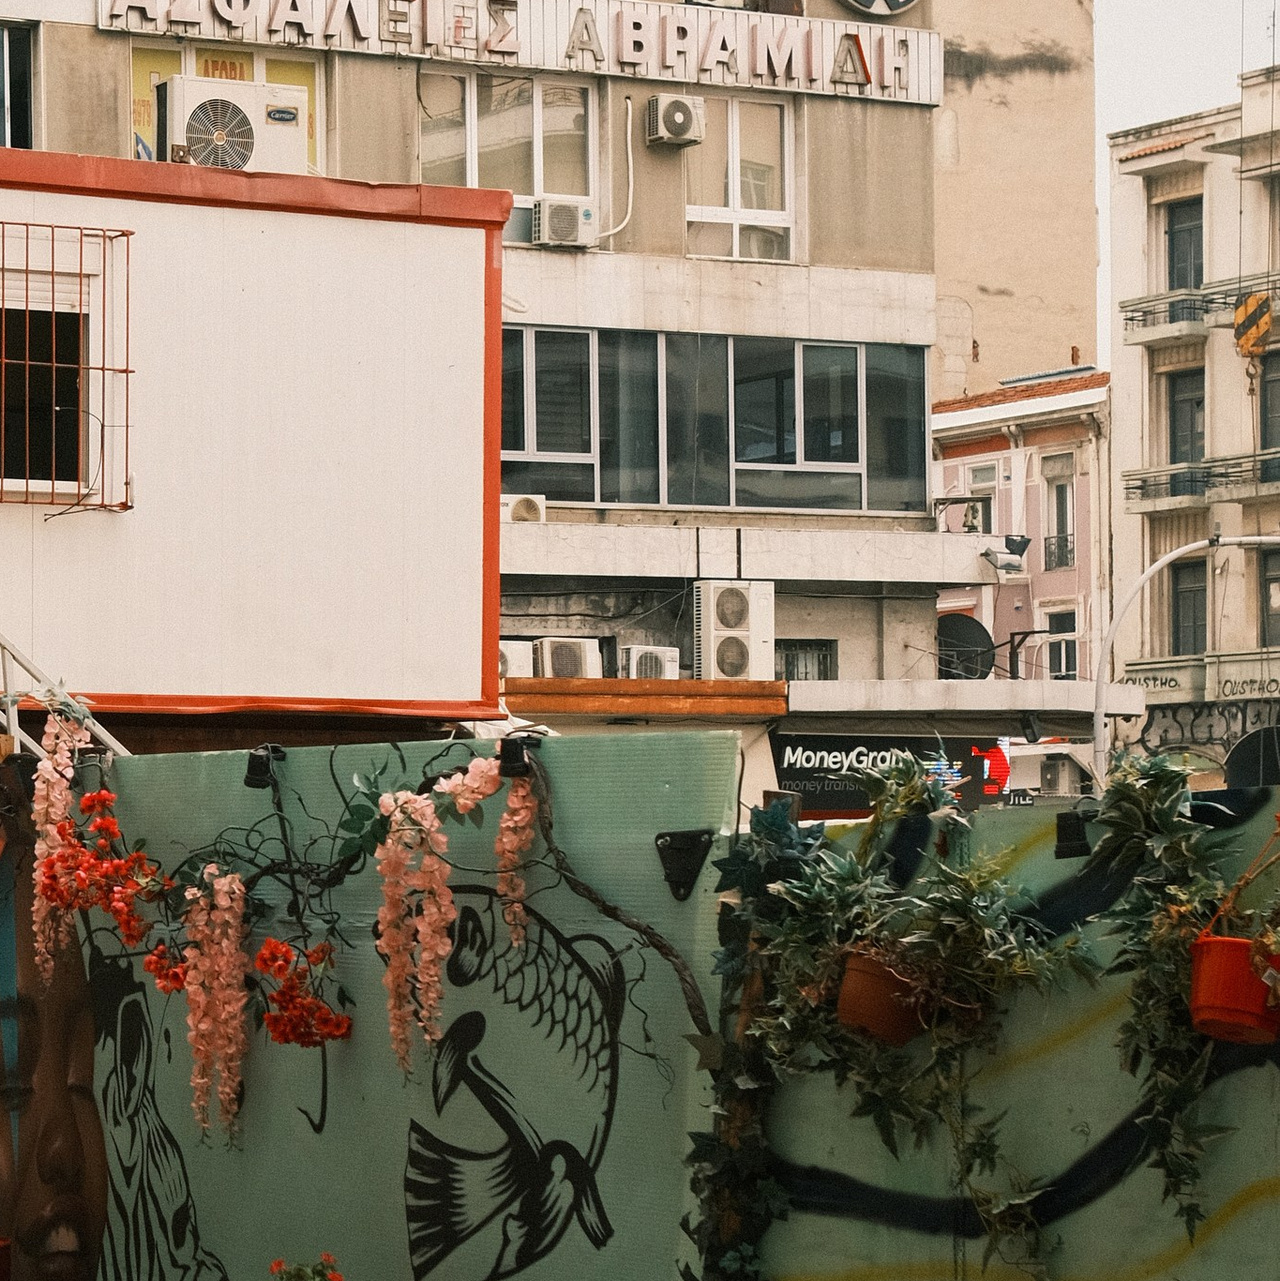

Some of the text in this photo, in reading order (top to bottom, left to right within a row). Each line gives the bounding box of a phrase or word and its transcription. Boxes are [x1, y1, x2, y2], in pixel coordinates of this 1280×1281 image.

[565, 7, 909, 91] ΑΒΡΑΜΙΔΗ
[270, 109, 297, 121] Carrier
[781, 780, 821, 794] money
